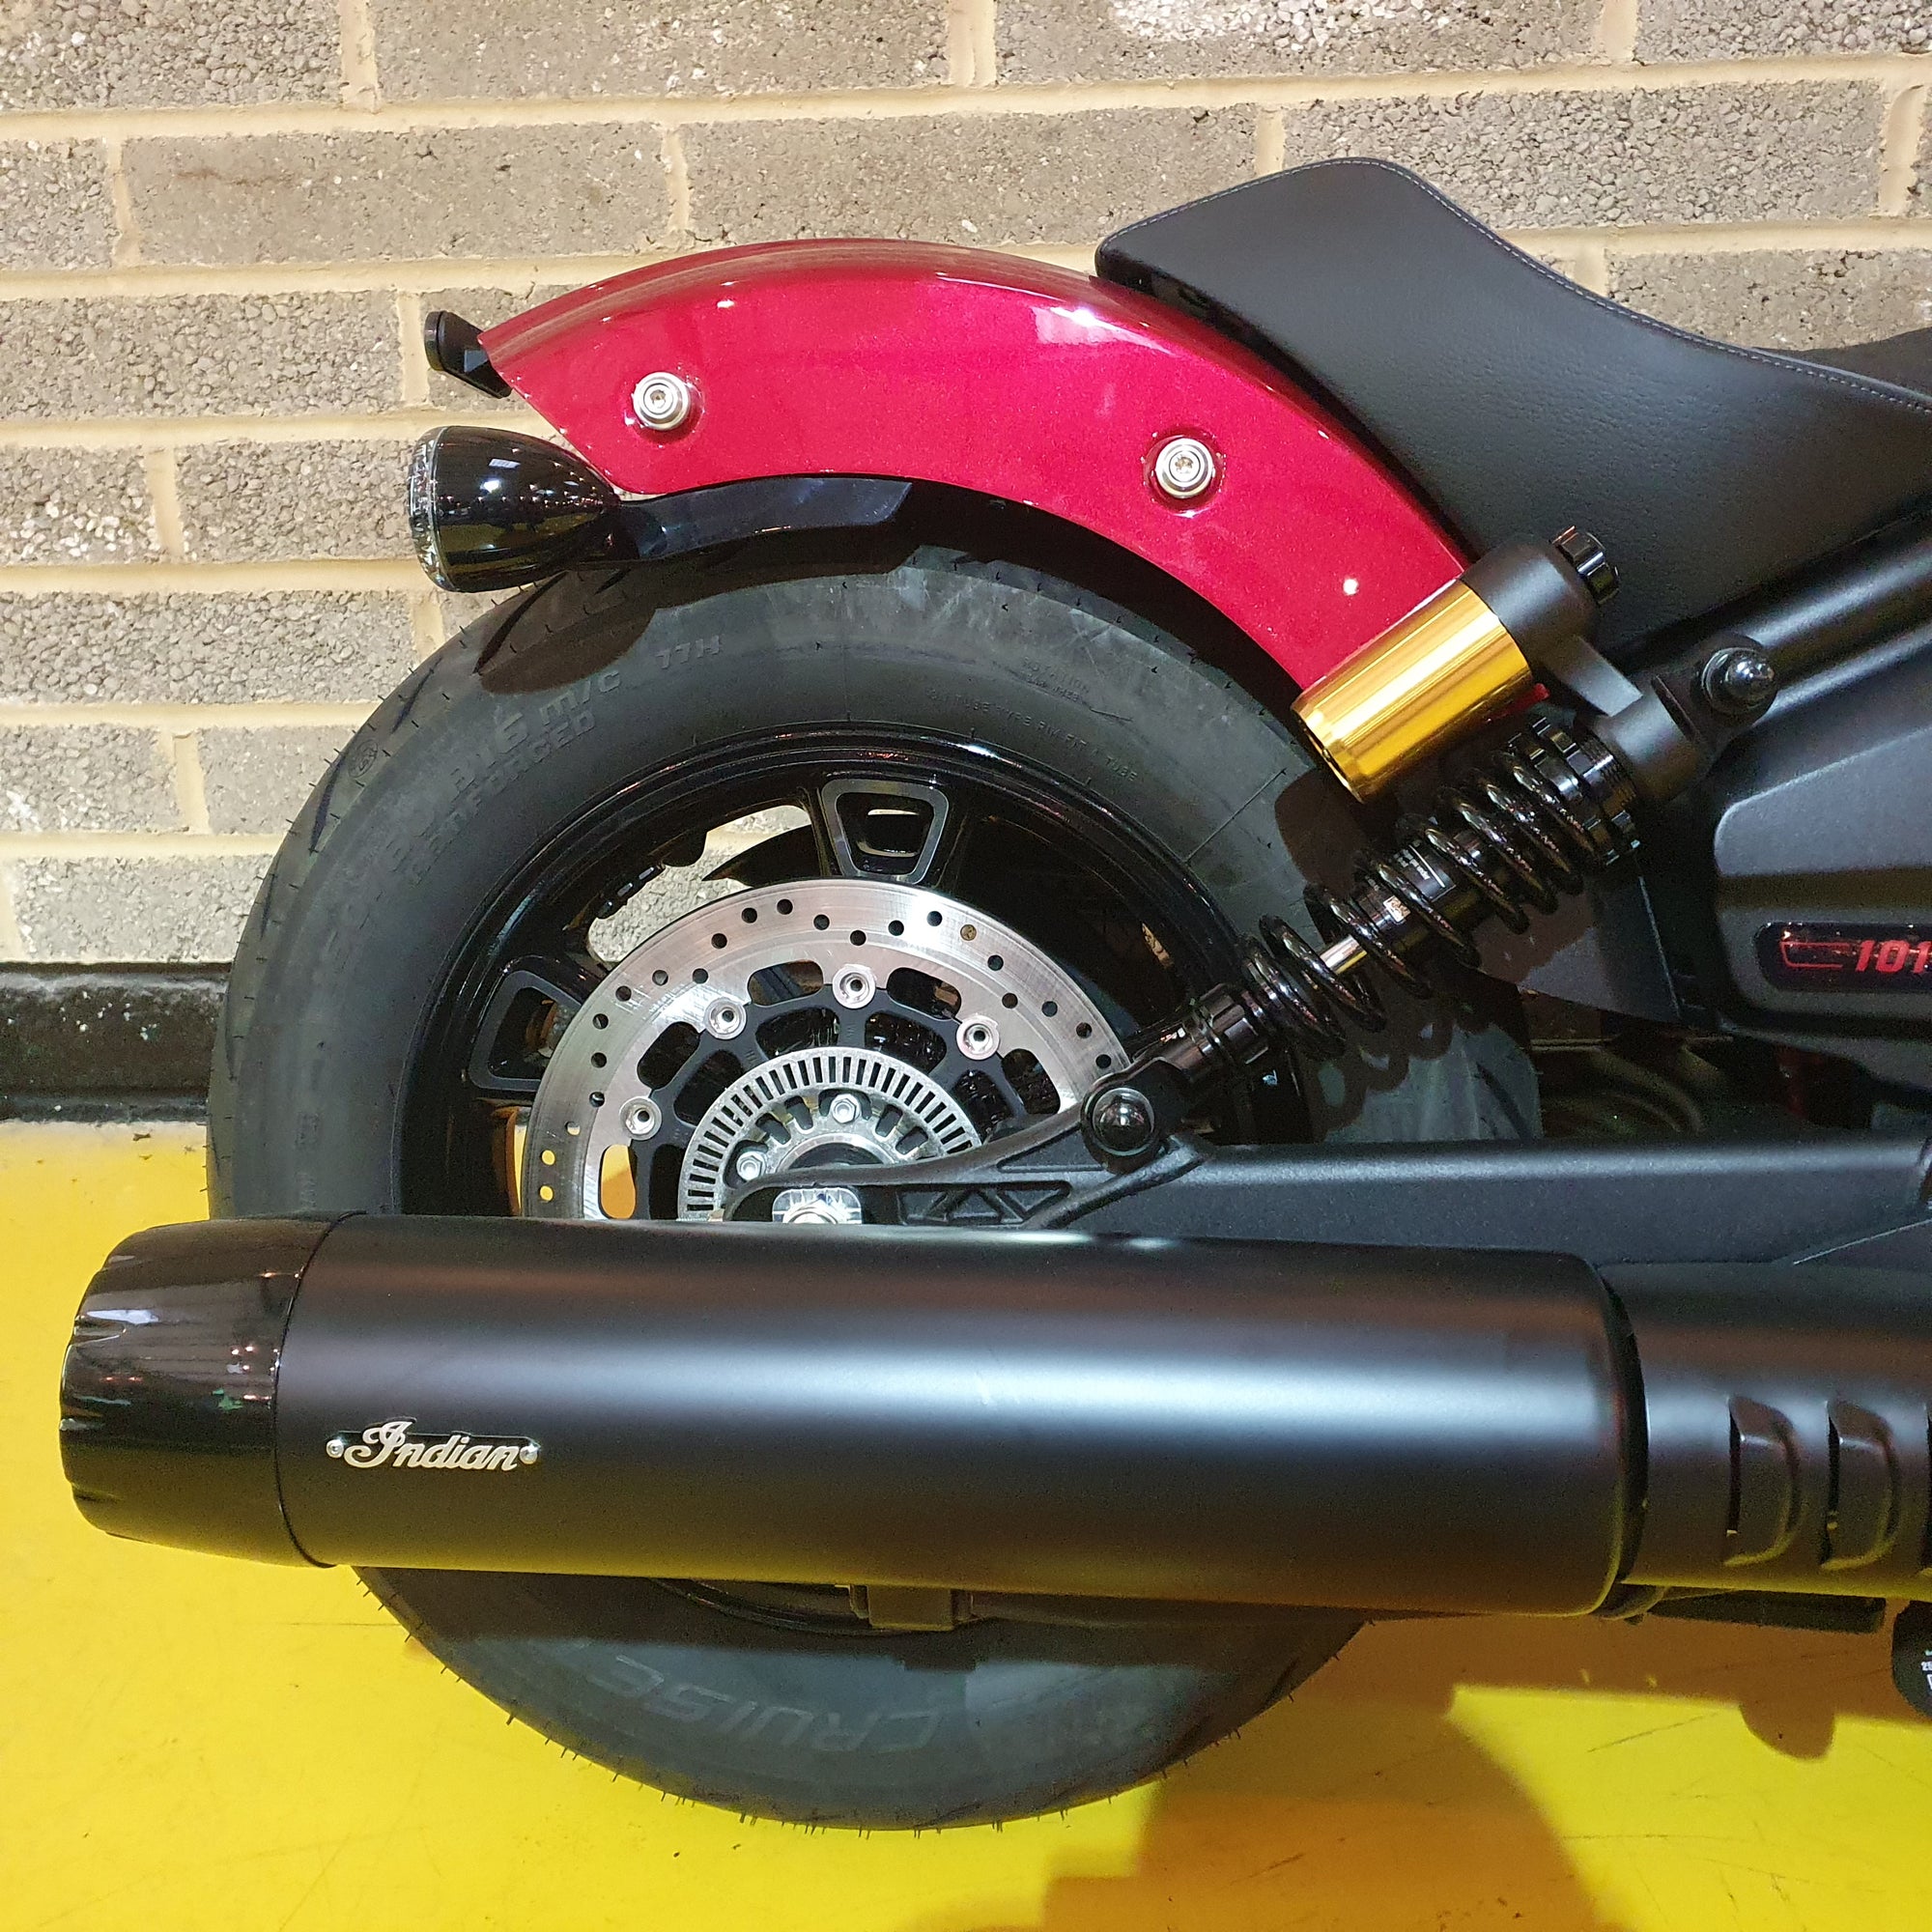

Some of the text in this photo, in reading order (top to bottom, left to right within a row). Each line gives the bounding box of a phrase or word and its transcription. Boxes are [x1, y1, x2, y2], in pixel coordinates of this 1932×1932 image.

[657, 634, 723, 670] 77H
[1104, 754, 1139, 782] TUBE
[1856, 940, 1932, 974] 101
[343, 1418, 520, 1471] Indian
